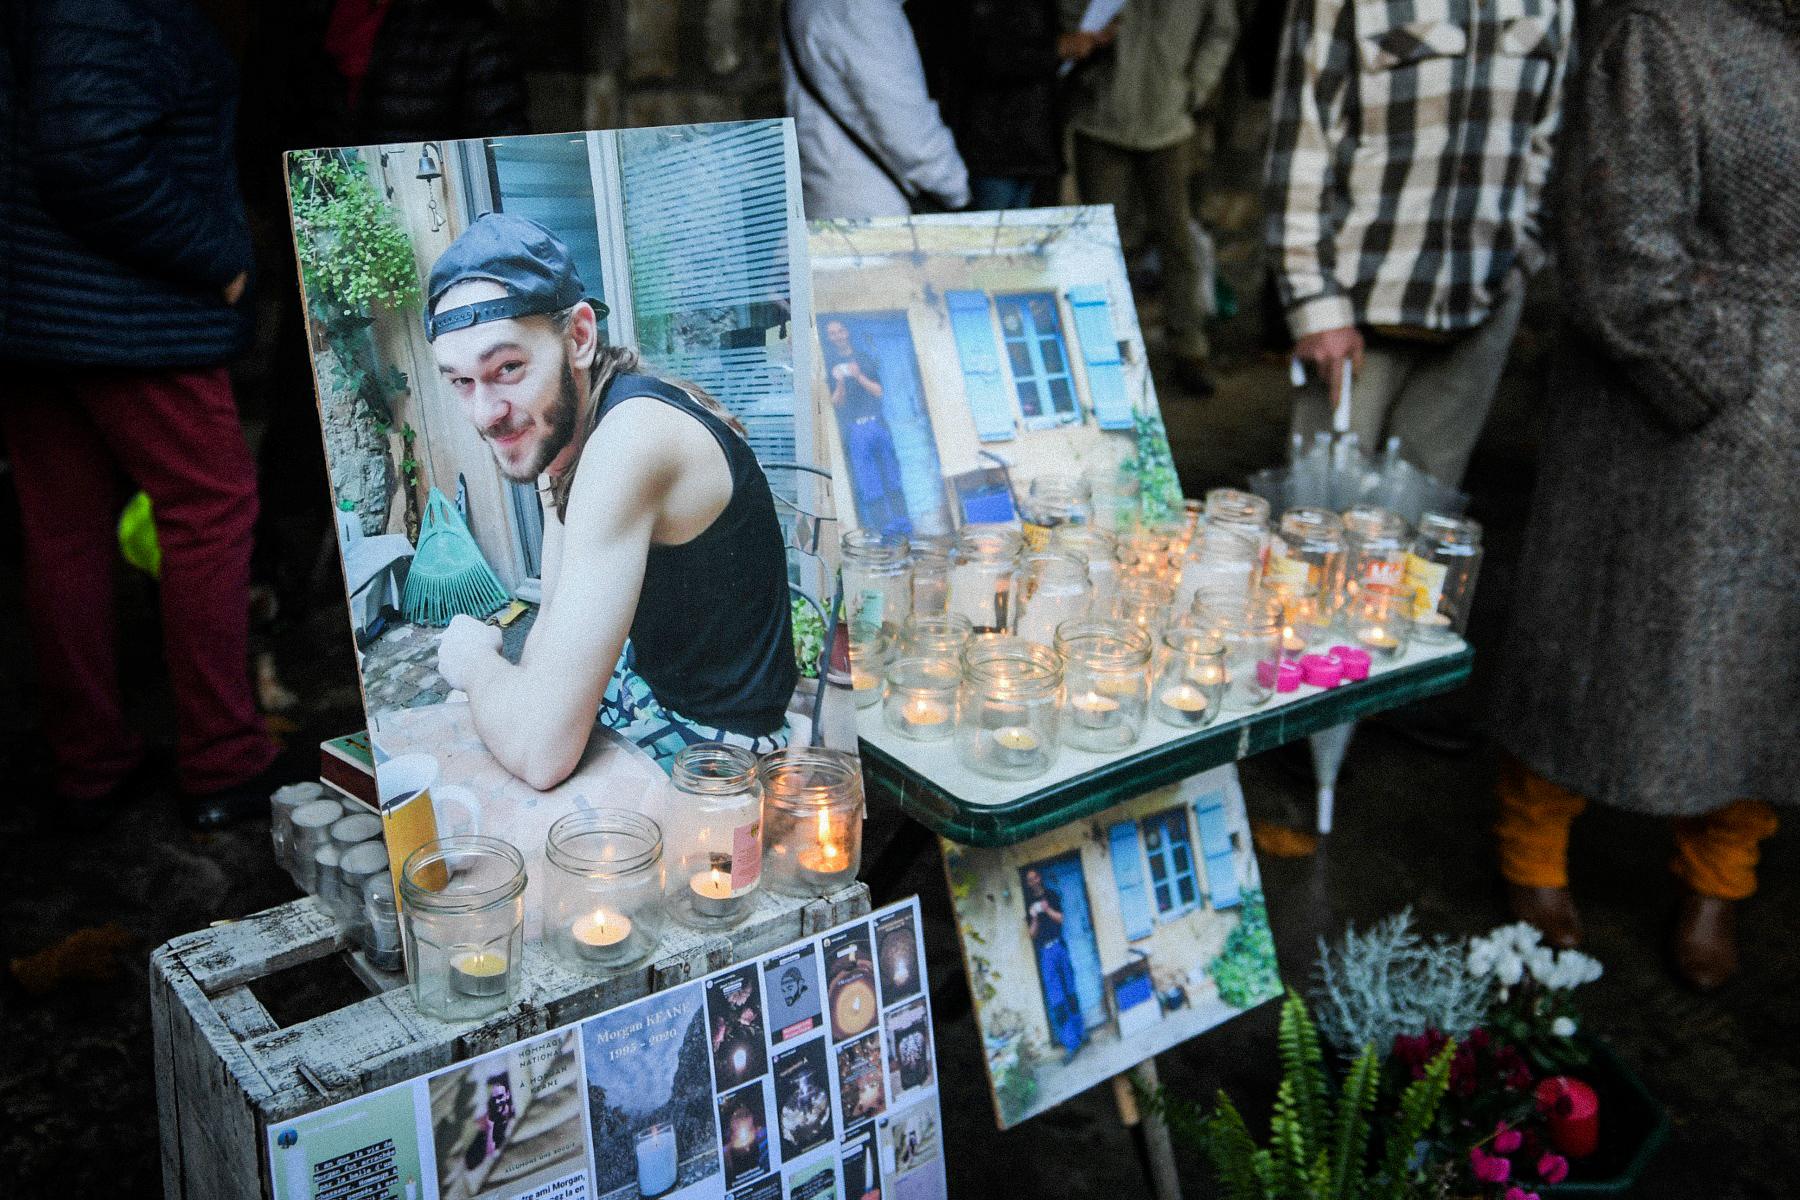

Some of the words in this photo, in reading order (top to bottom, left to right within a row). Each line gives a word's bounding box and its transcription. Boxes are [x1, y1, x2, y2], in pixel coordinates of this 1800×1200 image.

[597, 1022, 643, 1044] Morgan
[646, 1002, 691, 1026] KEANE
[536, 1186, 550, 1198] ami
[552, 1174, 586, 1191] Morgan,
[565, 1189, 573, 1198] la
[575, 1185, 585, 1193] en
